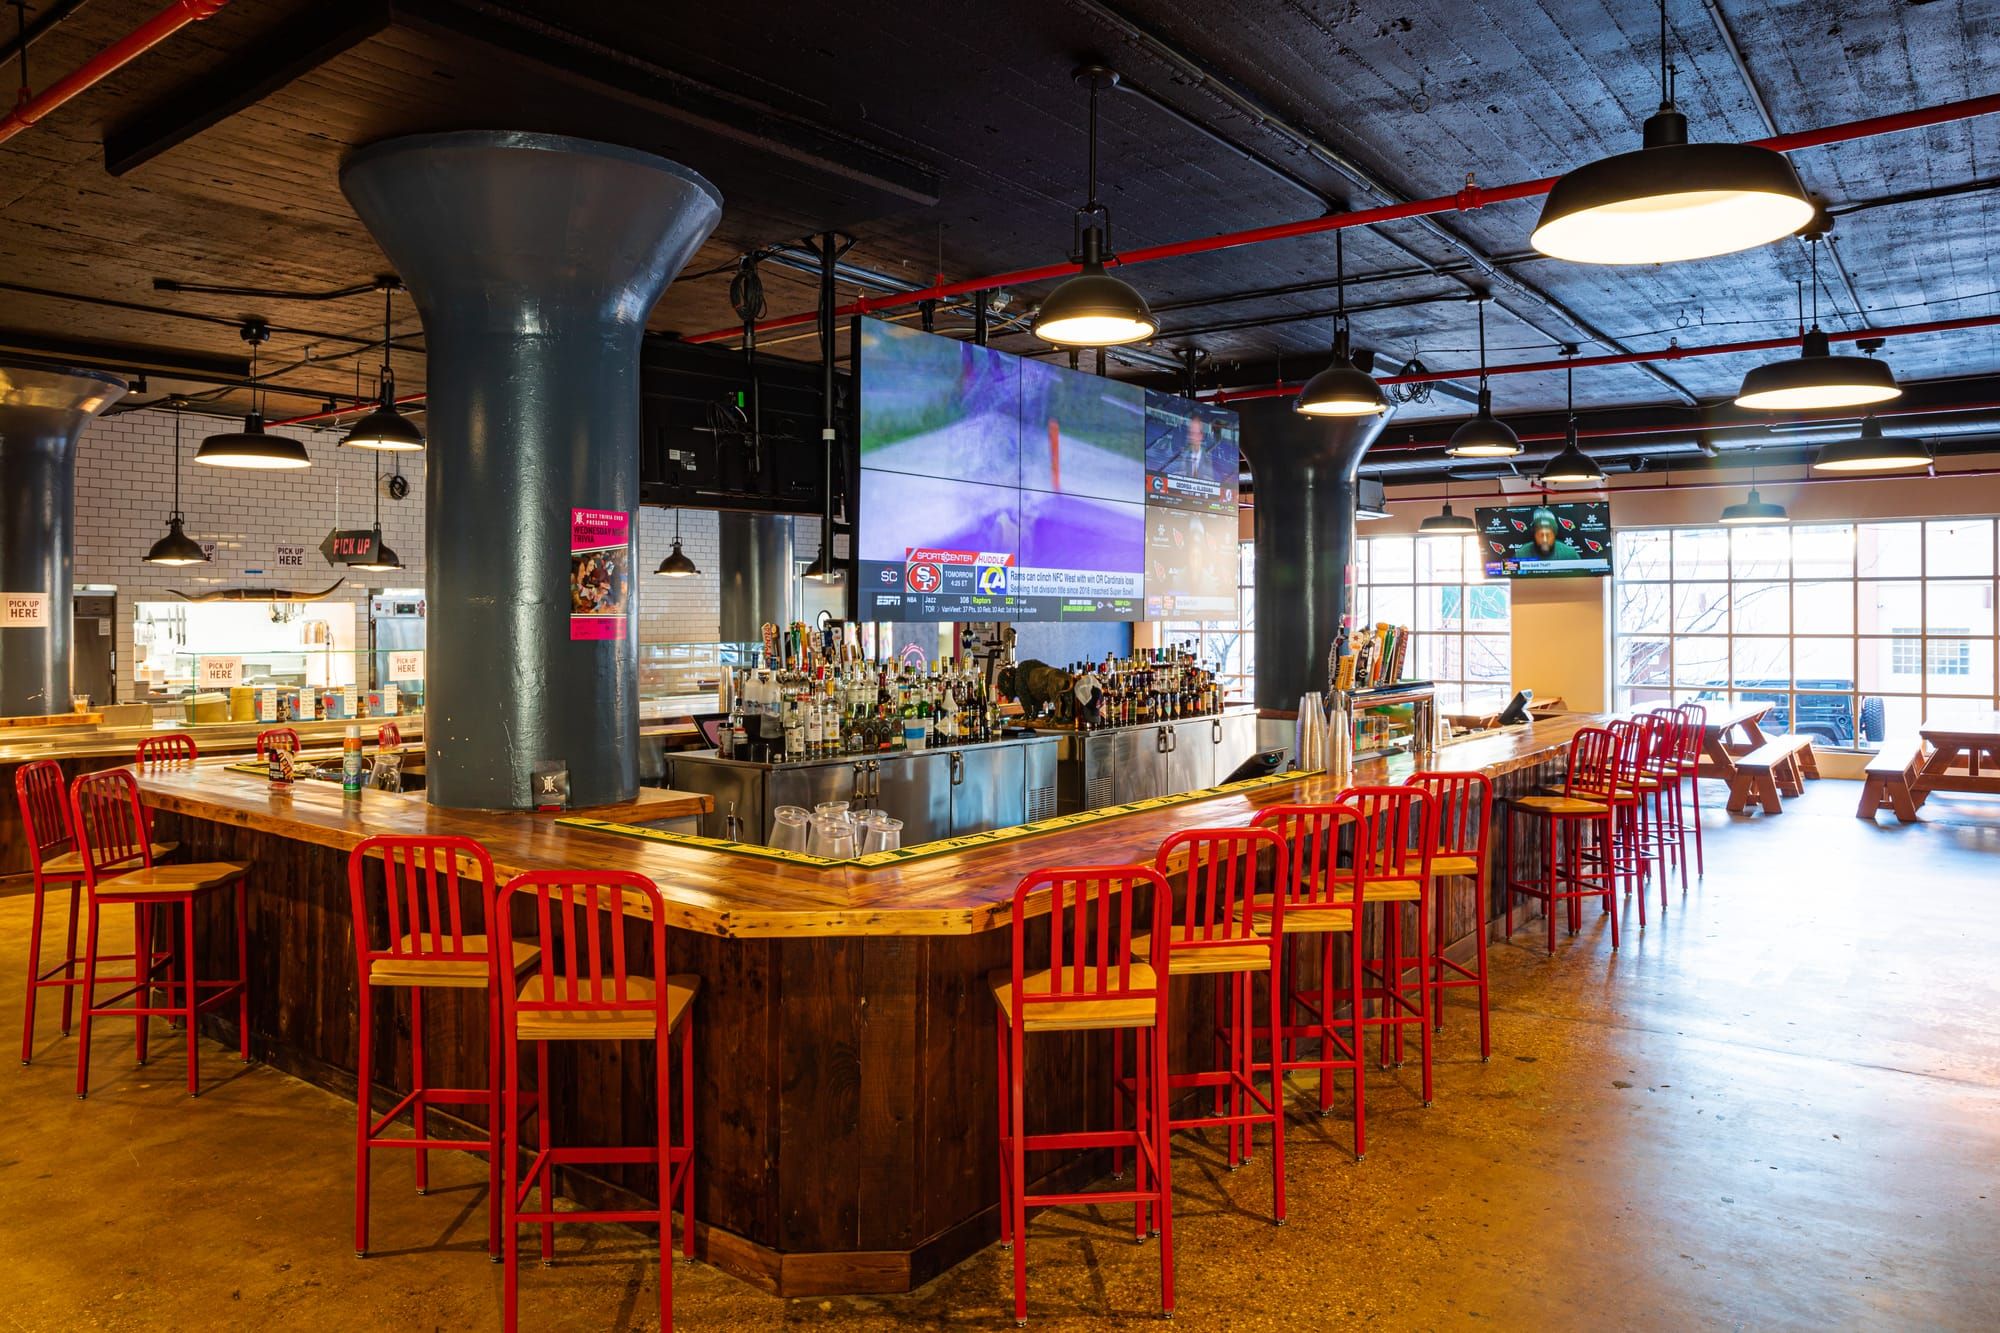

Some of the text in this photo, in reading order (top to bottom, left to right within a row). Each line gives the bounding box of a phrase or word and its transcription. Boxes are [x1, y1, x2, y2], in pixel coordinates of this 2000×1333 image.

[574, 527, 612, 536] WEDNESDAY
[574, 535, 594, 543] TRIVIA
[332, 538, 370, 555] PICK UP
[279, 556, 302, 566] HERE
[978, 556, 1004, 564] HUDDLE
[881, 571, 898, 582] SC
[1010, 571, 1026, 581] Rams
[1036, 572, 1052, 582] clinch
[1052, 573, 1063, 582] NFC
[1064, 574, 1076, 583] West
[1076, 574, 1086, 583] with
[1096, 574, 1104, 584] OR
[1104, 575, 1124, 585] Cardinals
[1125, 576, 1134, 585] loss
[1040, 586, 1057, 594] division
[876, 596, 900, 606] ESPN
[972, 597, 992, 605] Raptors
[11, 608, 38, 618] HERE
[398, 664, 416, 672] HERE
[210, 670, 232, 678] HERE
